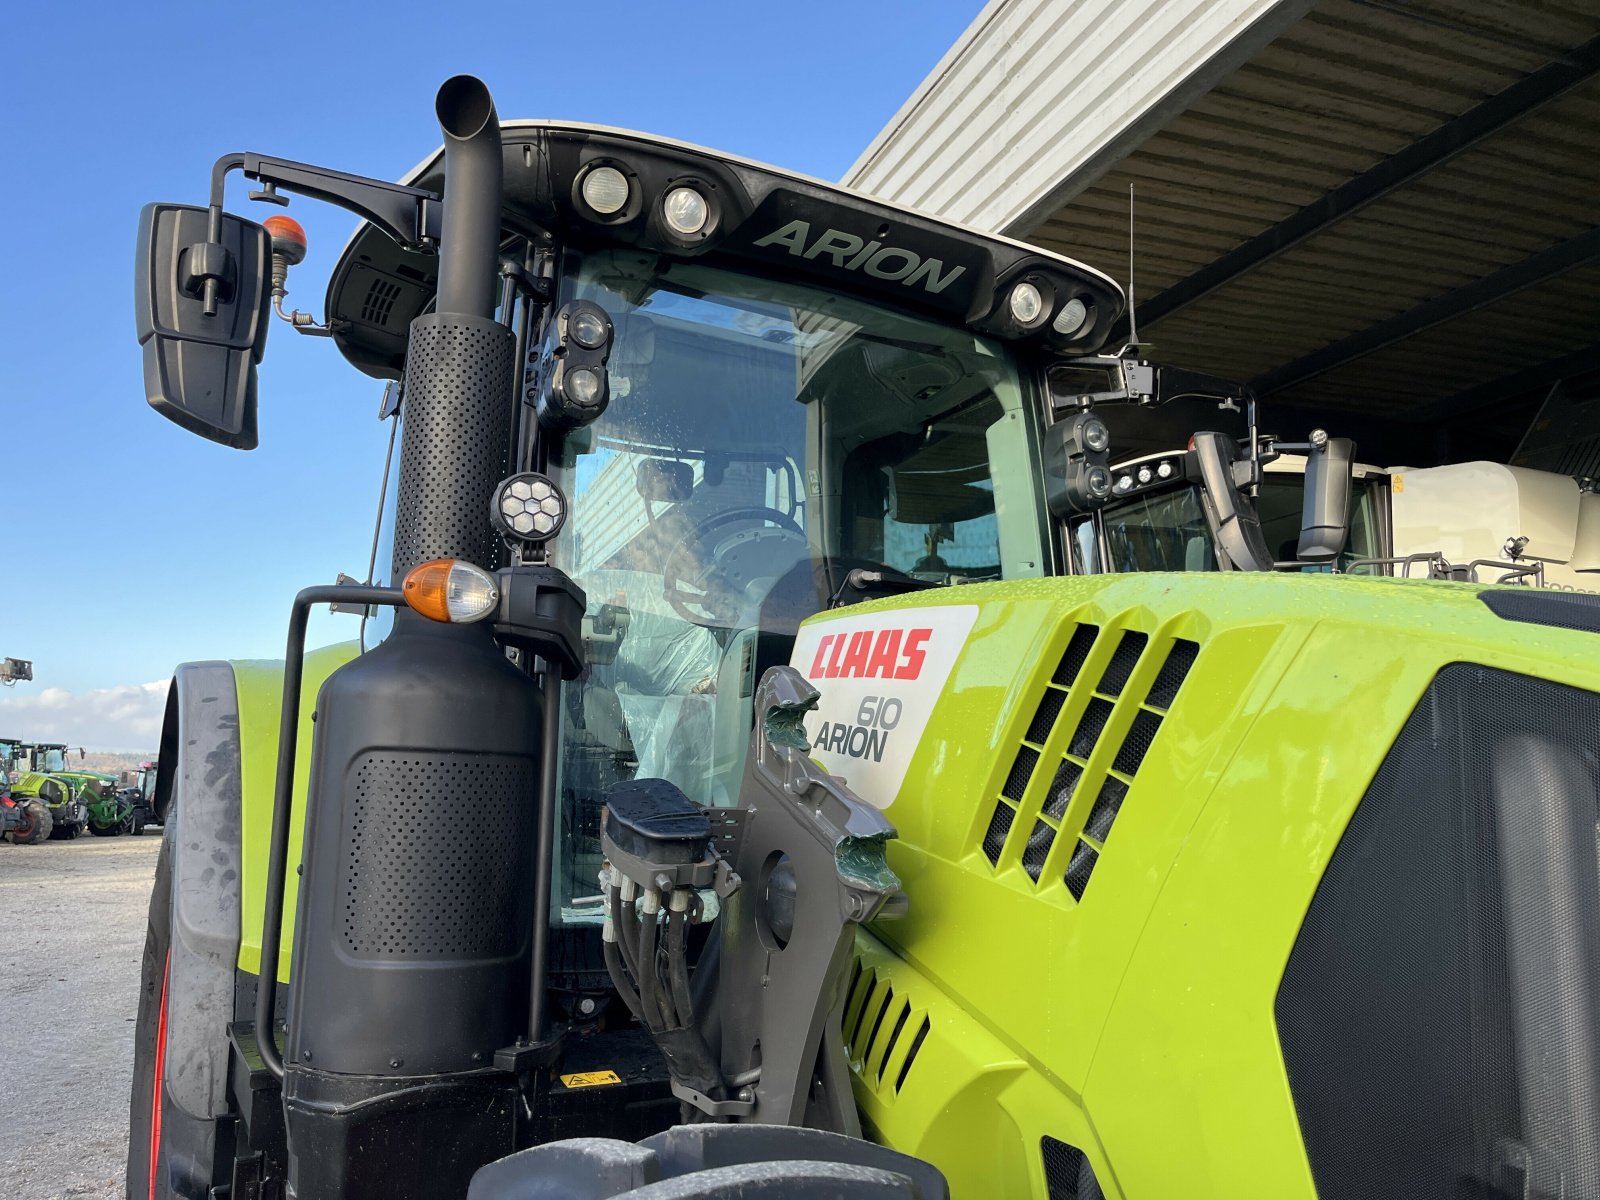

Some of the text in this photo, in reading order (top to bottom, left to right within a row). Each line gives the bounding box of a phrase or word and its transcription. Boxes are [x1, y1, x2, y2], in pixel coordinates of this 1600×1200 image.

[752, 219, 967, 294] ARION
[809, 628, 933, 681] CLAAS
[856, 695, 903, 731] 610
[813, 721, 889, 763] ARION
